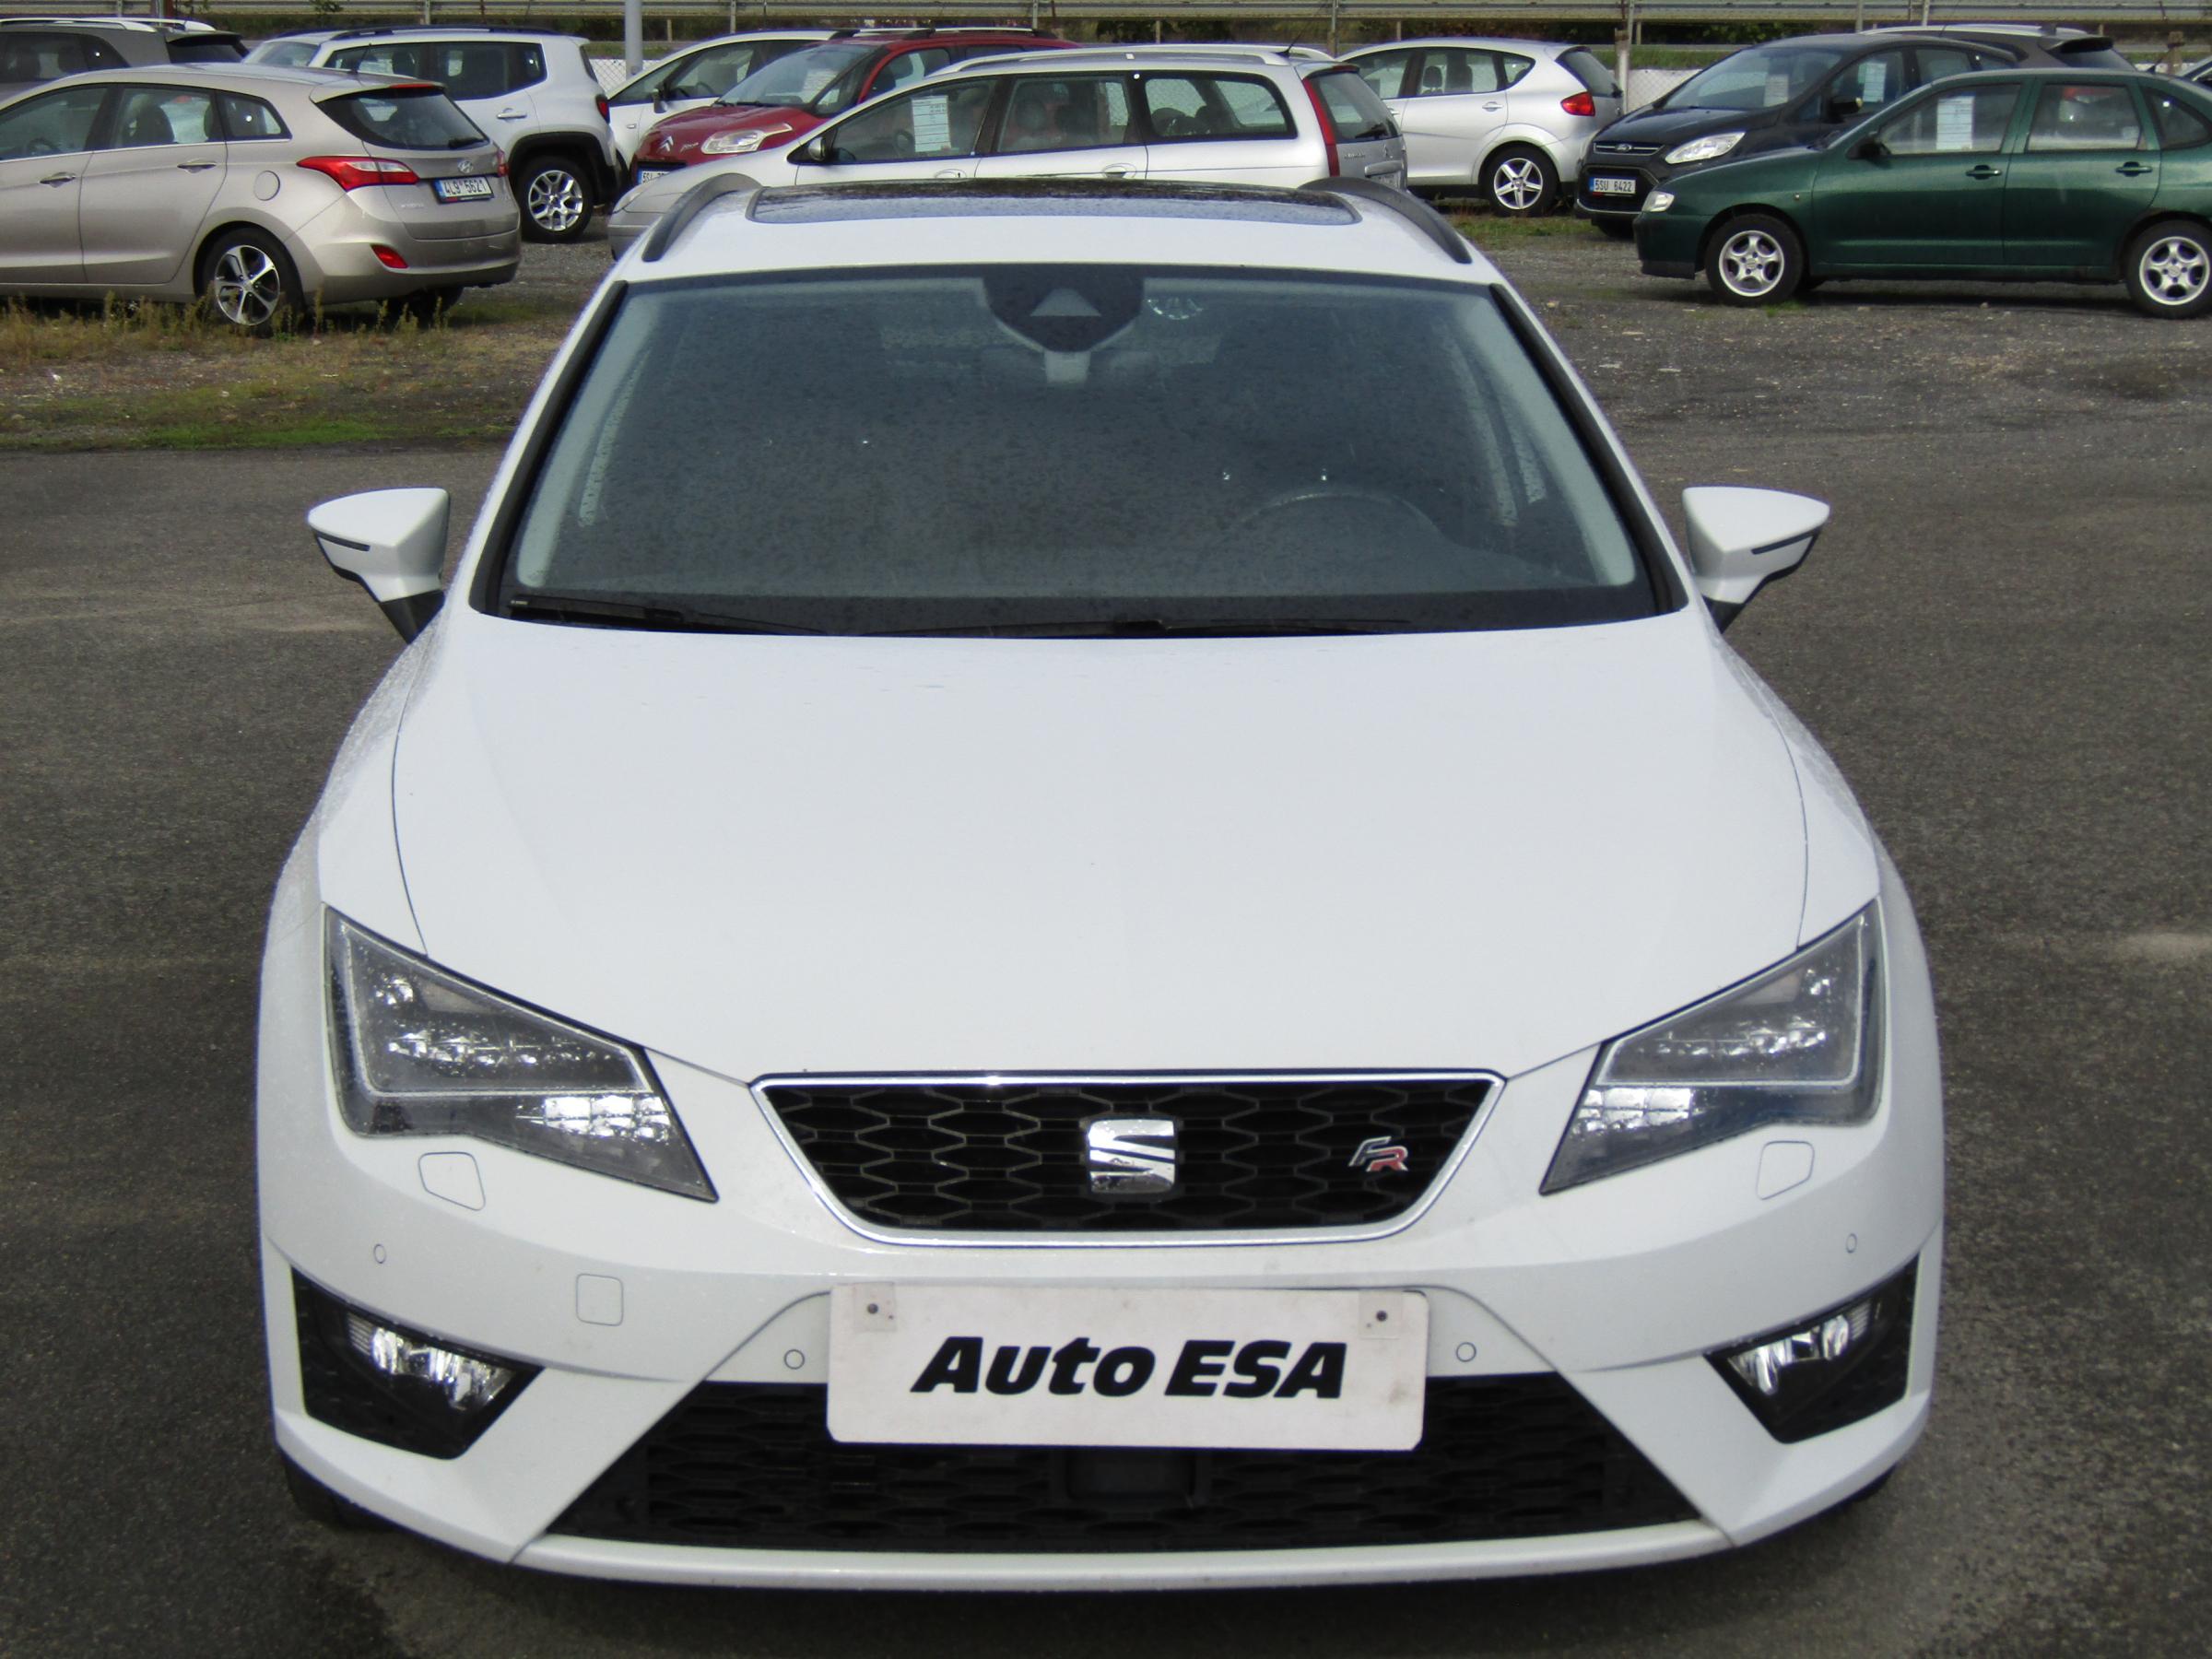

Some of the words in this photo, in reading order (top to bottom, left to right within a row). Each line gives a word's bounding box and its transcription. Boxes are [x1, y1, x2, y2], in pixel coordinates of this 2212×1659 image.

[1595, 179, 1608, 191] 5SU
[1614, 181, 1632, 193] 6422
[1347, 1135, 1409, 1172] FR
[910, 1336, 1156, 1396] Auto
[1164, 1340, 1347, 1398] ESA
